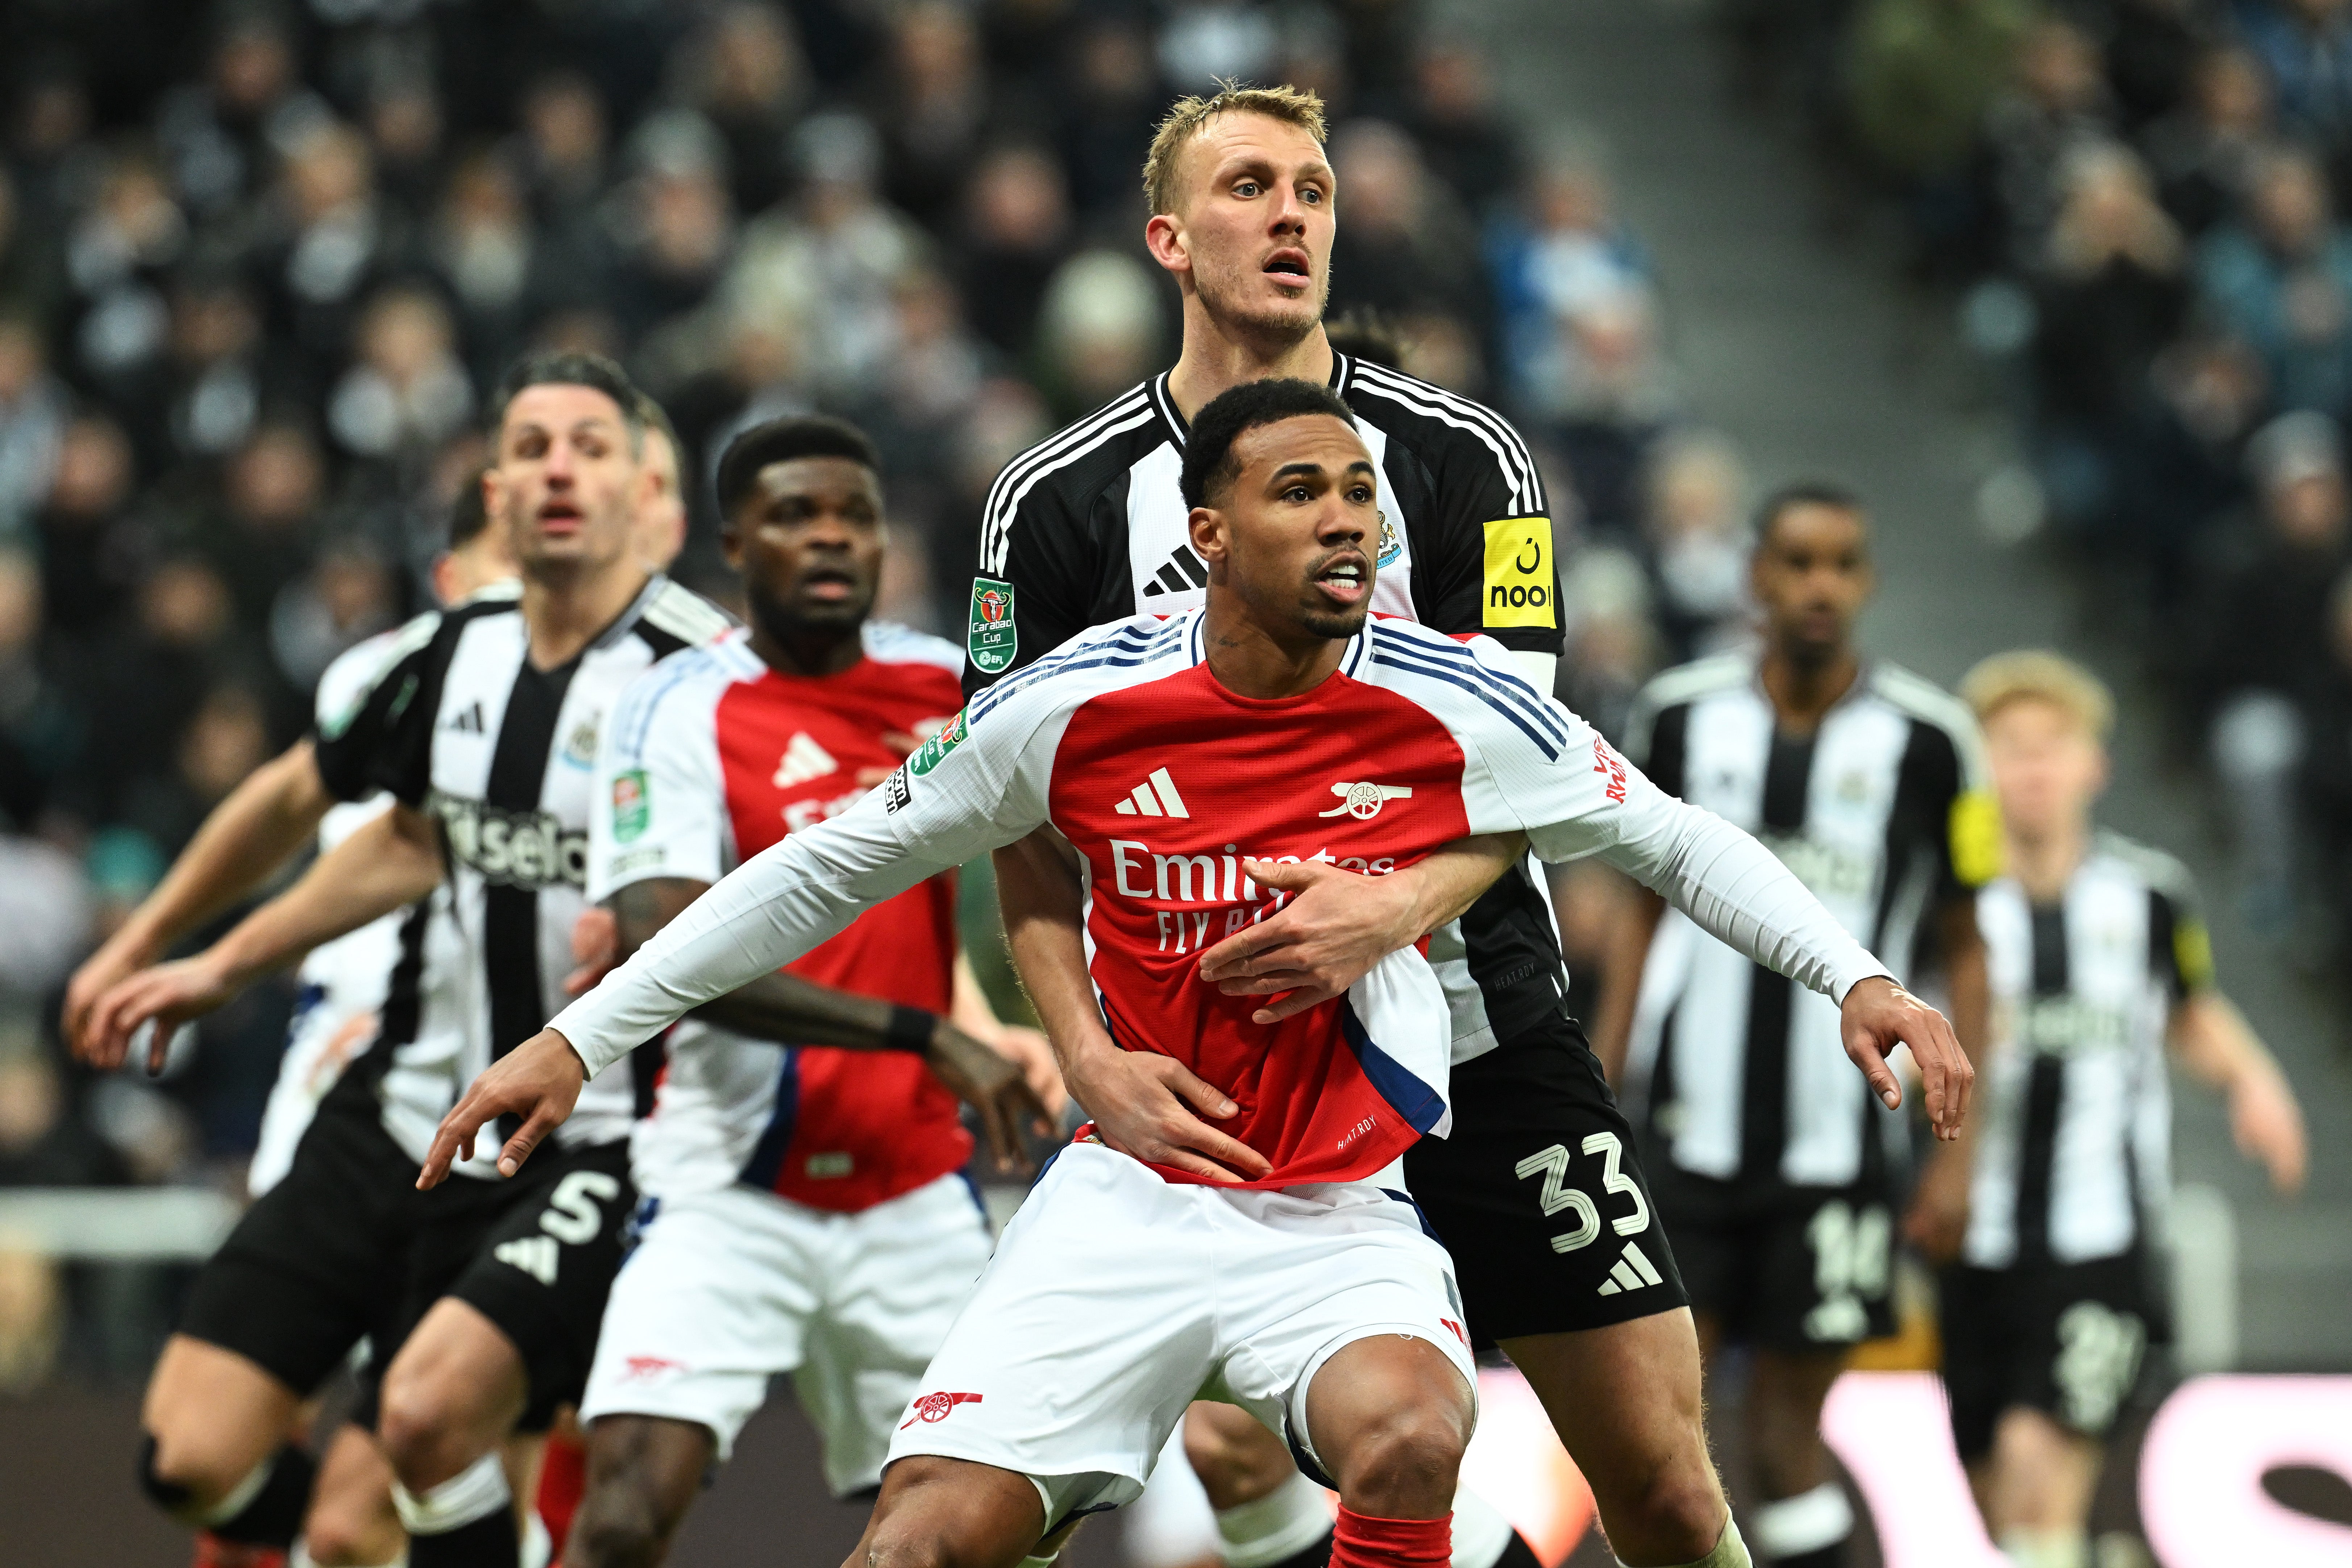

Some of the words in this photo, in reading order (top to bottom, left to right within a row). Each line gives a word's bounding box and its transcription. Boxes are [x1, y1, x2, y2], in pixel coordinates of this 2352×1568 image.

[1377, 557, 1392, 566] NITED
[972, 619, 1012, 633] Carabao
[983, 633, 1001, 644] Cup
[991, 655, 1003, 665] EFL
[936, 728, 946, 758] arabao
[1158, 911, 1210, 954] FLY
[1515, 1131, 1650, 1254] 33
[539, 1170, 620, 1245] 5
